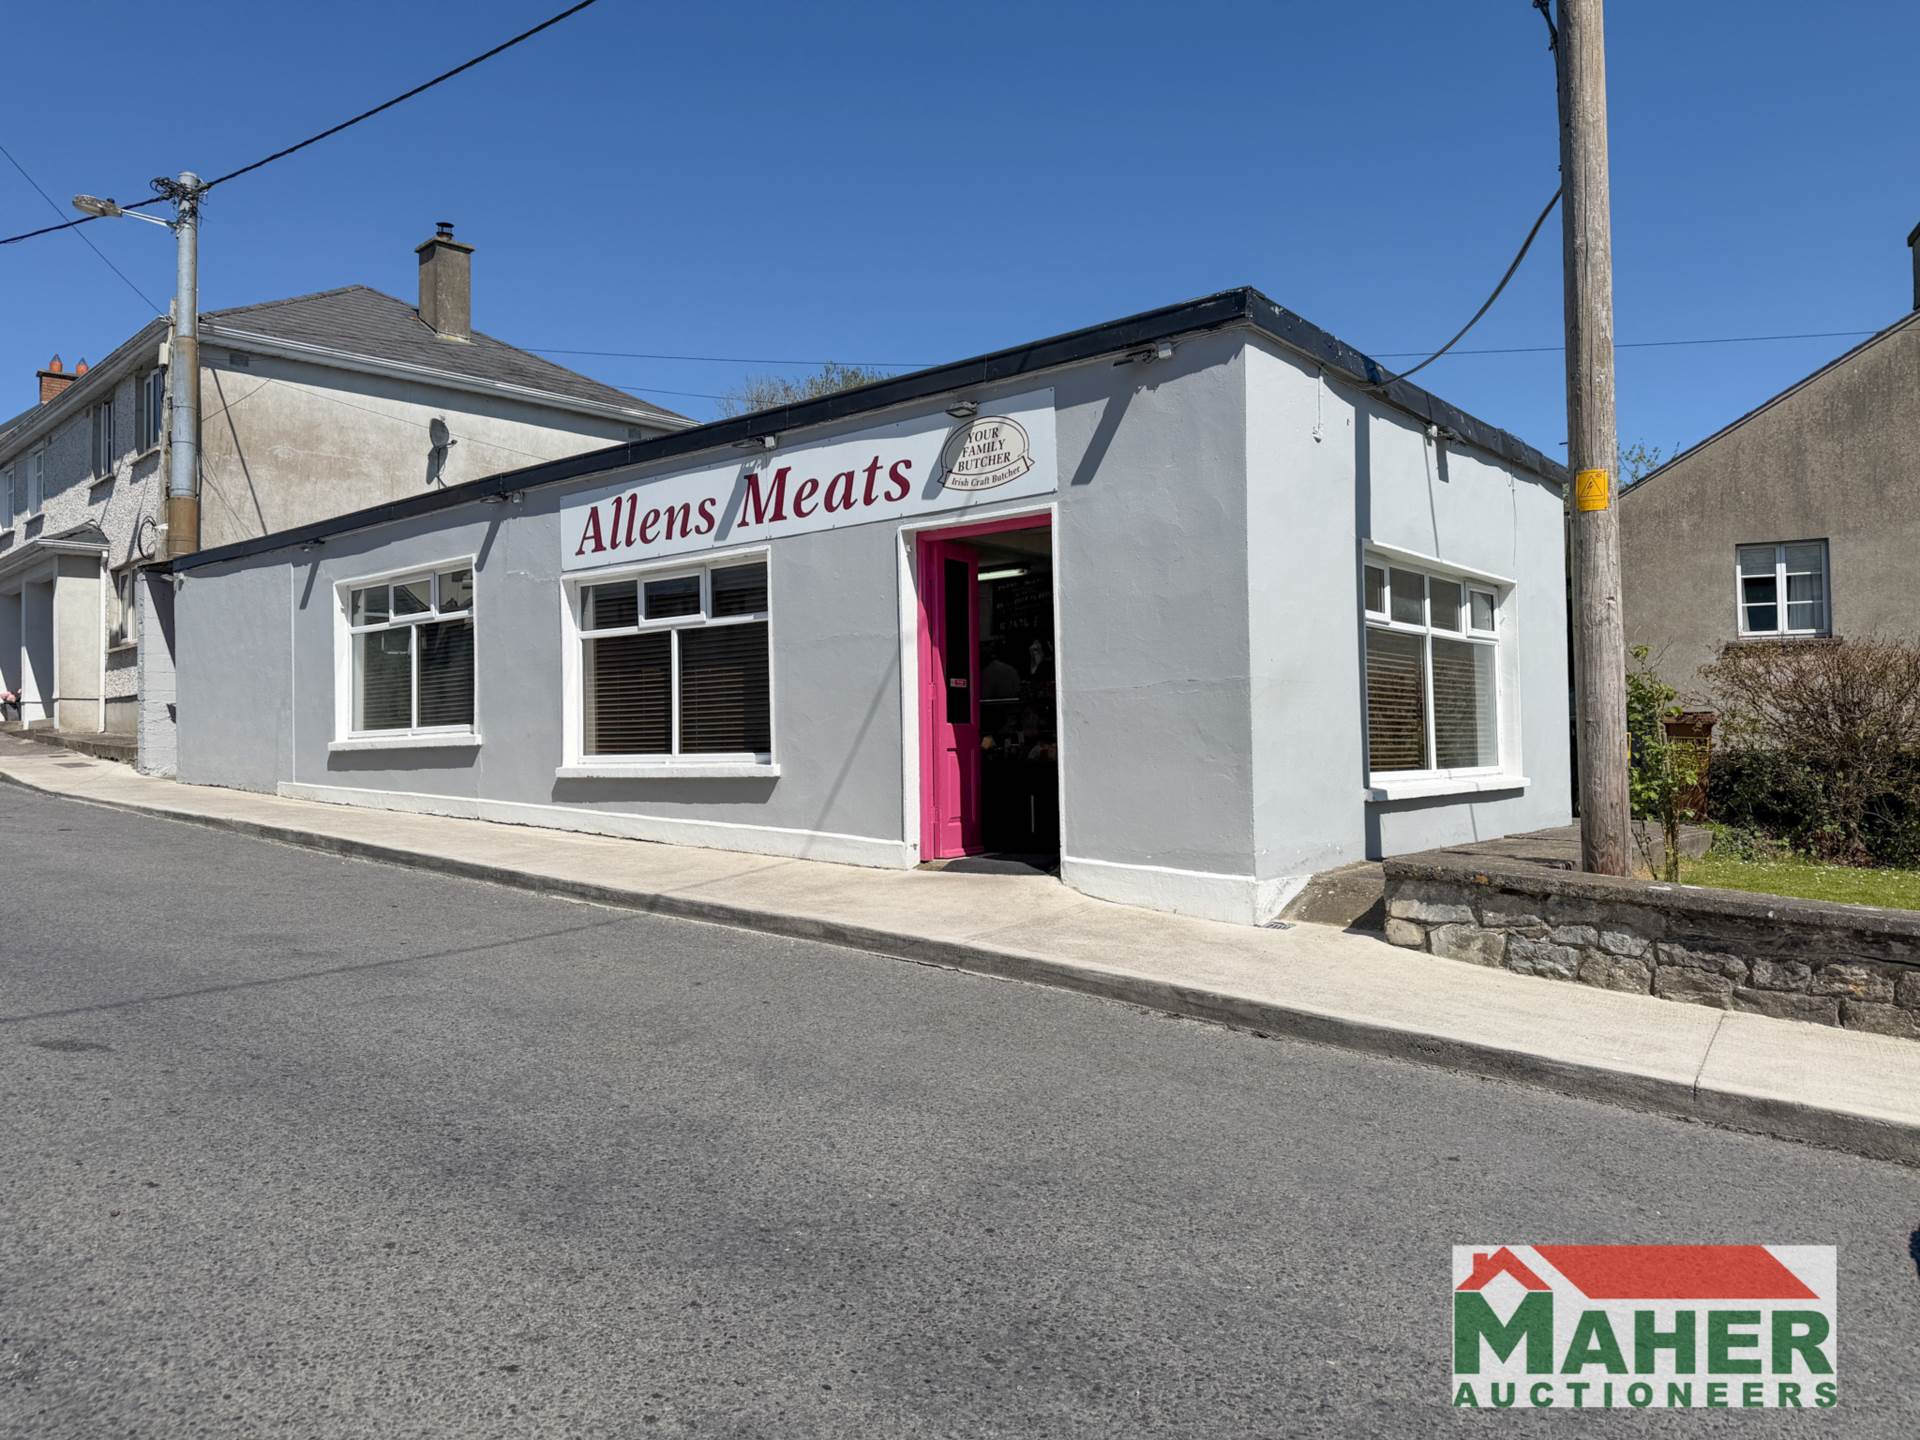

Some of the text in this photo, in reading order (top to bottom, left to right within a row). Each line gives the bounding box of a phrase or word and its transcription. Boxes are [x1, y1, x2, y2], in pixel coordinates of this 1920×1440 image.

[967, 427, 999, 443] YOUR
[962, 439, 1006, 458] FAMILY
[958, 451, 1011, 472] BUTCHER
[951, 466, 1021, 487] Irish Craft Butcher
[575, 455, 912, 555] Allens Meats
